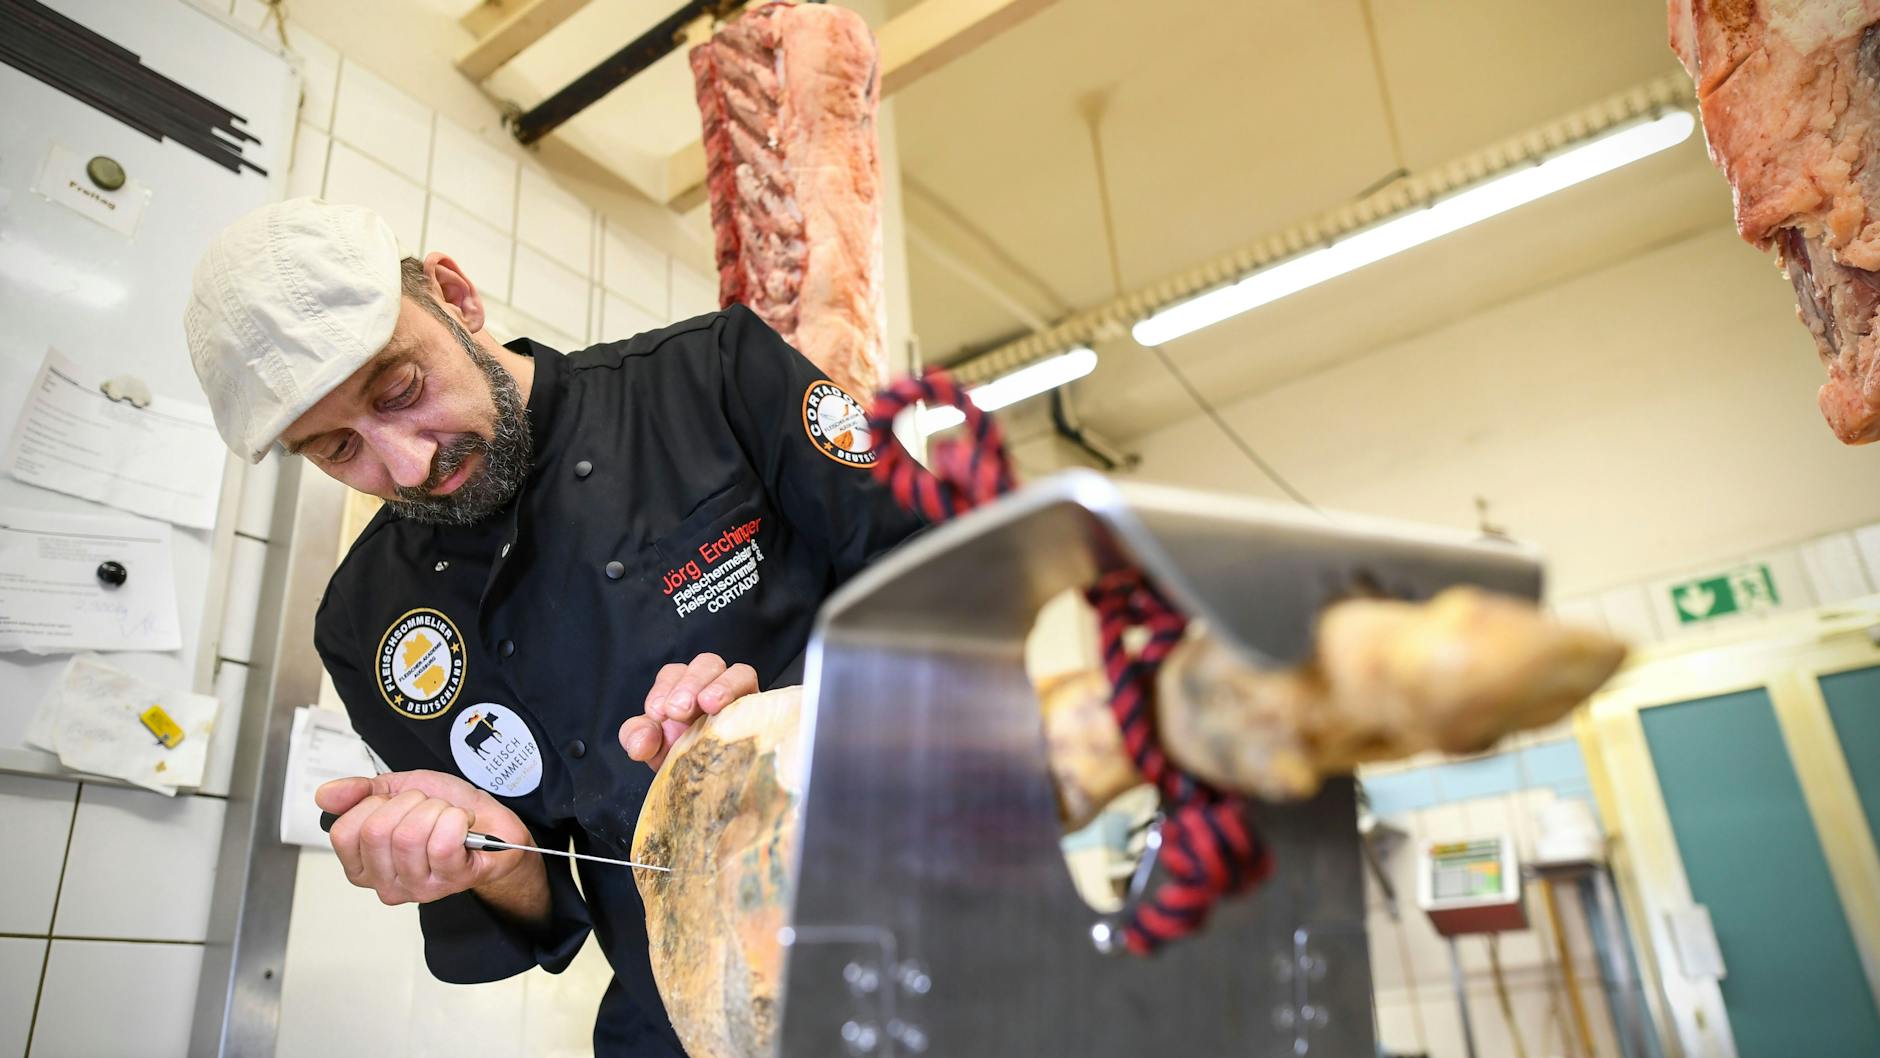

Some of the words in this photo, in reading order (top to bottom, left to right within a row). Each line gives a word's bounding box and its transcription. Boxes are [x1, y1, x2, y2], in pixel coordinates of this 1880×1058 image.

[837, 450, 877, 463] DEUTSC
[663, 560, 702, 596] Jörg
[699, 518, 761, 564] Erchinger
[750, 538, 759, 552] &
[756, 549, 765, 563] &
[382, 615, 453, 693] FLEISCHSOMMELIER
[407, 659, 462, 714] DEUTSCHLAND
[485, 737, 521, 774] FLEISCH
[490, 742, 536, 791] SOMMELIER
